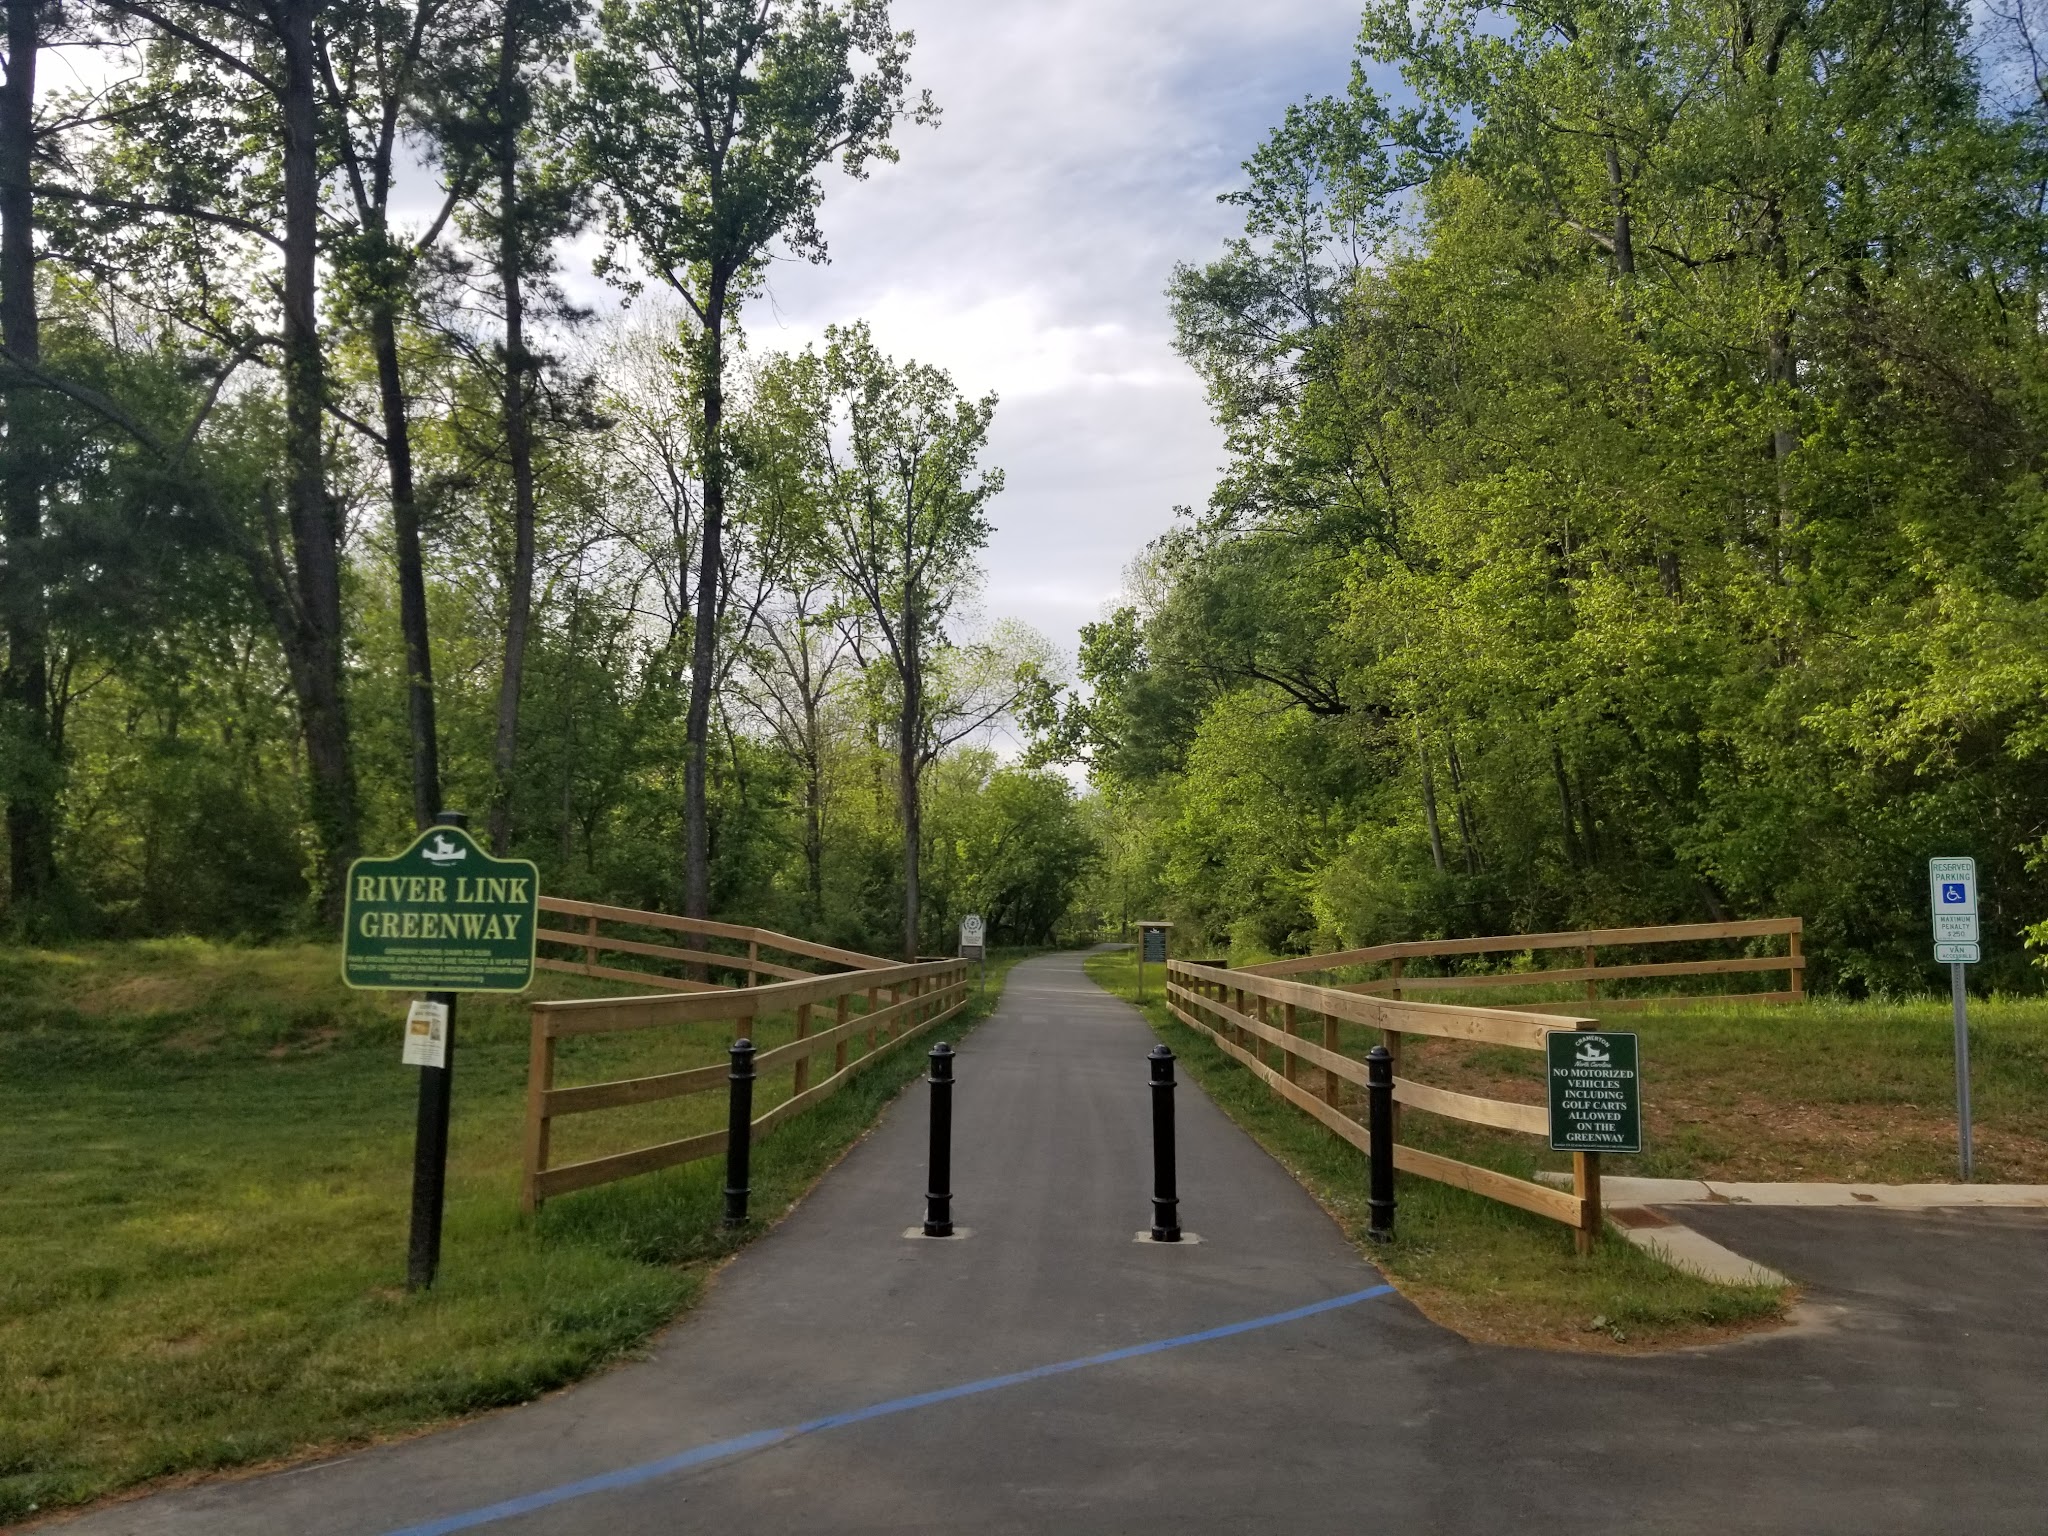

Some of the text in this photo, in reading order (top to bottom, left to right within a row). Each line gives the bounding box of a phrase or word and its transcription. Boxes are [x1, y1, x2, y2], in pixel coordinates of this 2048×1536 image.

[1933, 863, 1972, 872] RESERVED
[1935, 873, 1971, 881] PARKING
[355, 875, 530, 904] RIVER LINK
[359, 911, 522, 940] GREENWAY
[1575, 1035, 1610, 1048] CRAMERTON
[1553, 1068, 1634, 1079] NO MOTORIZED
[1568, 1079, 1620, 1088] VEHICLES
[1565, 1090, 1624, 1100] INCLUDING
[1562, 1101, 1627, 1110] GOLF CARTS
[1568, 1112, 1621, 1121] ALLOWED
[1577, 1122, 1616, 1131] ON THE
[1566, 1132, 1625, 1143] GREENWAY
